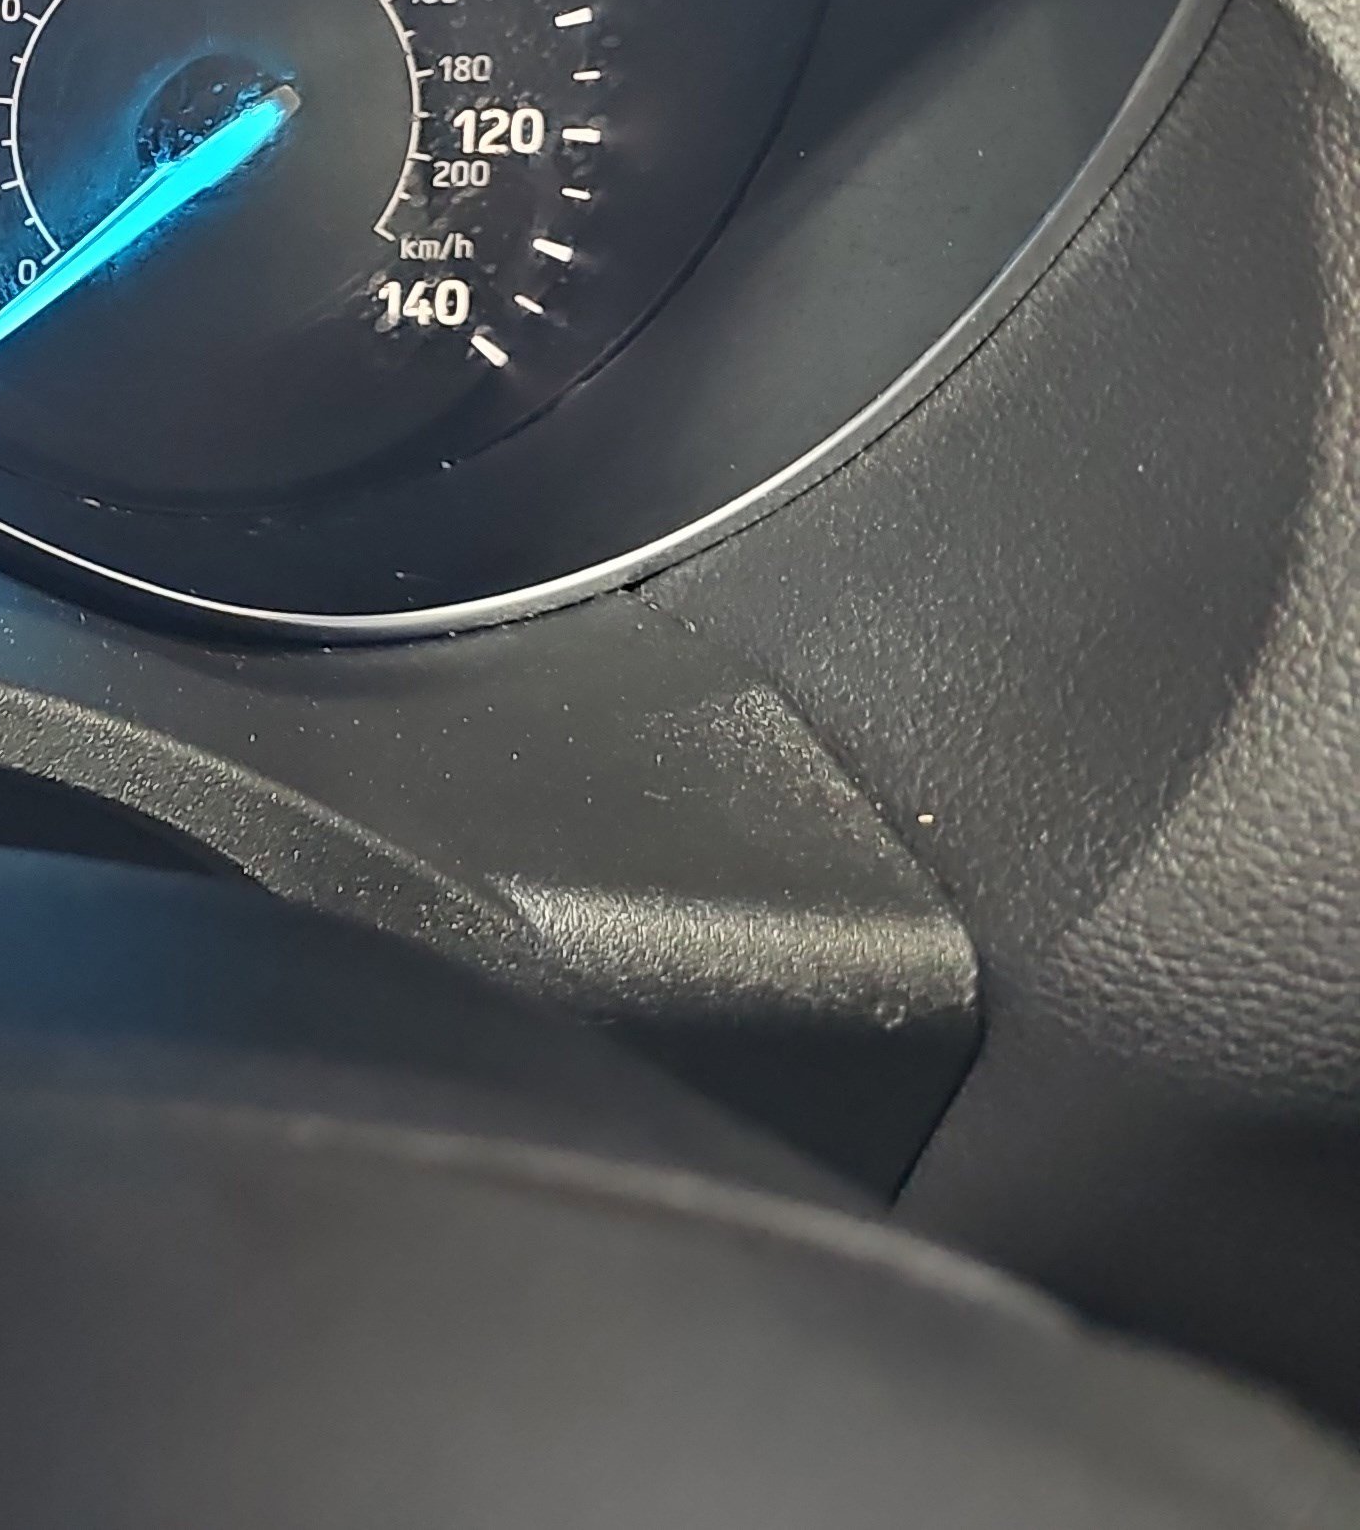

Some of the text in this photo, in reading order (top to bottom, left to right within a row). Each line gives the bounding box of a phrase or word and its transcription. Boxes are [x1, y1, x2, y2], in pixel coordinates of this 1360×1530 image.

[437, 54, 492, 82] 180
[452, 109, 545, 154] 120
[432, 160, 491, 188] 200
[399, 234, 474, 261] km/h
[17, 258, 37, 286] 0
[376, 281, 470, 327] 140
